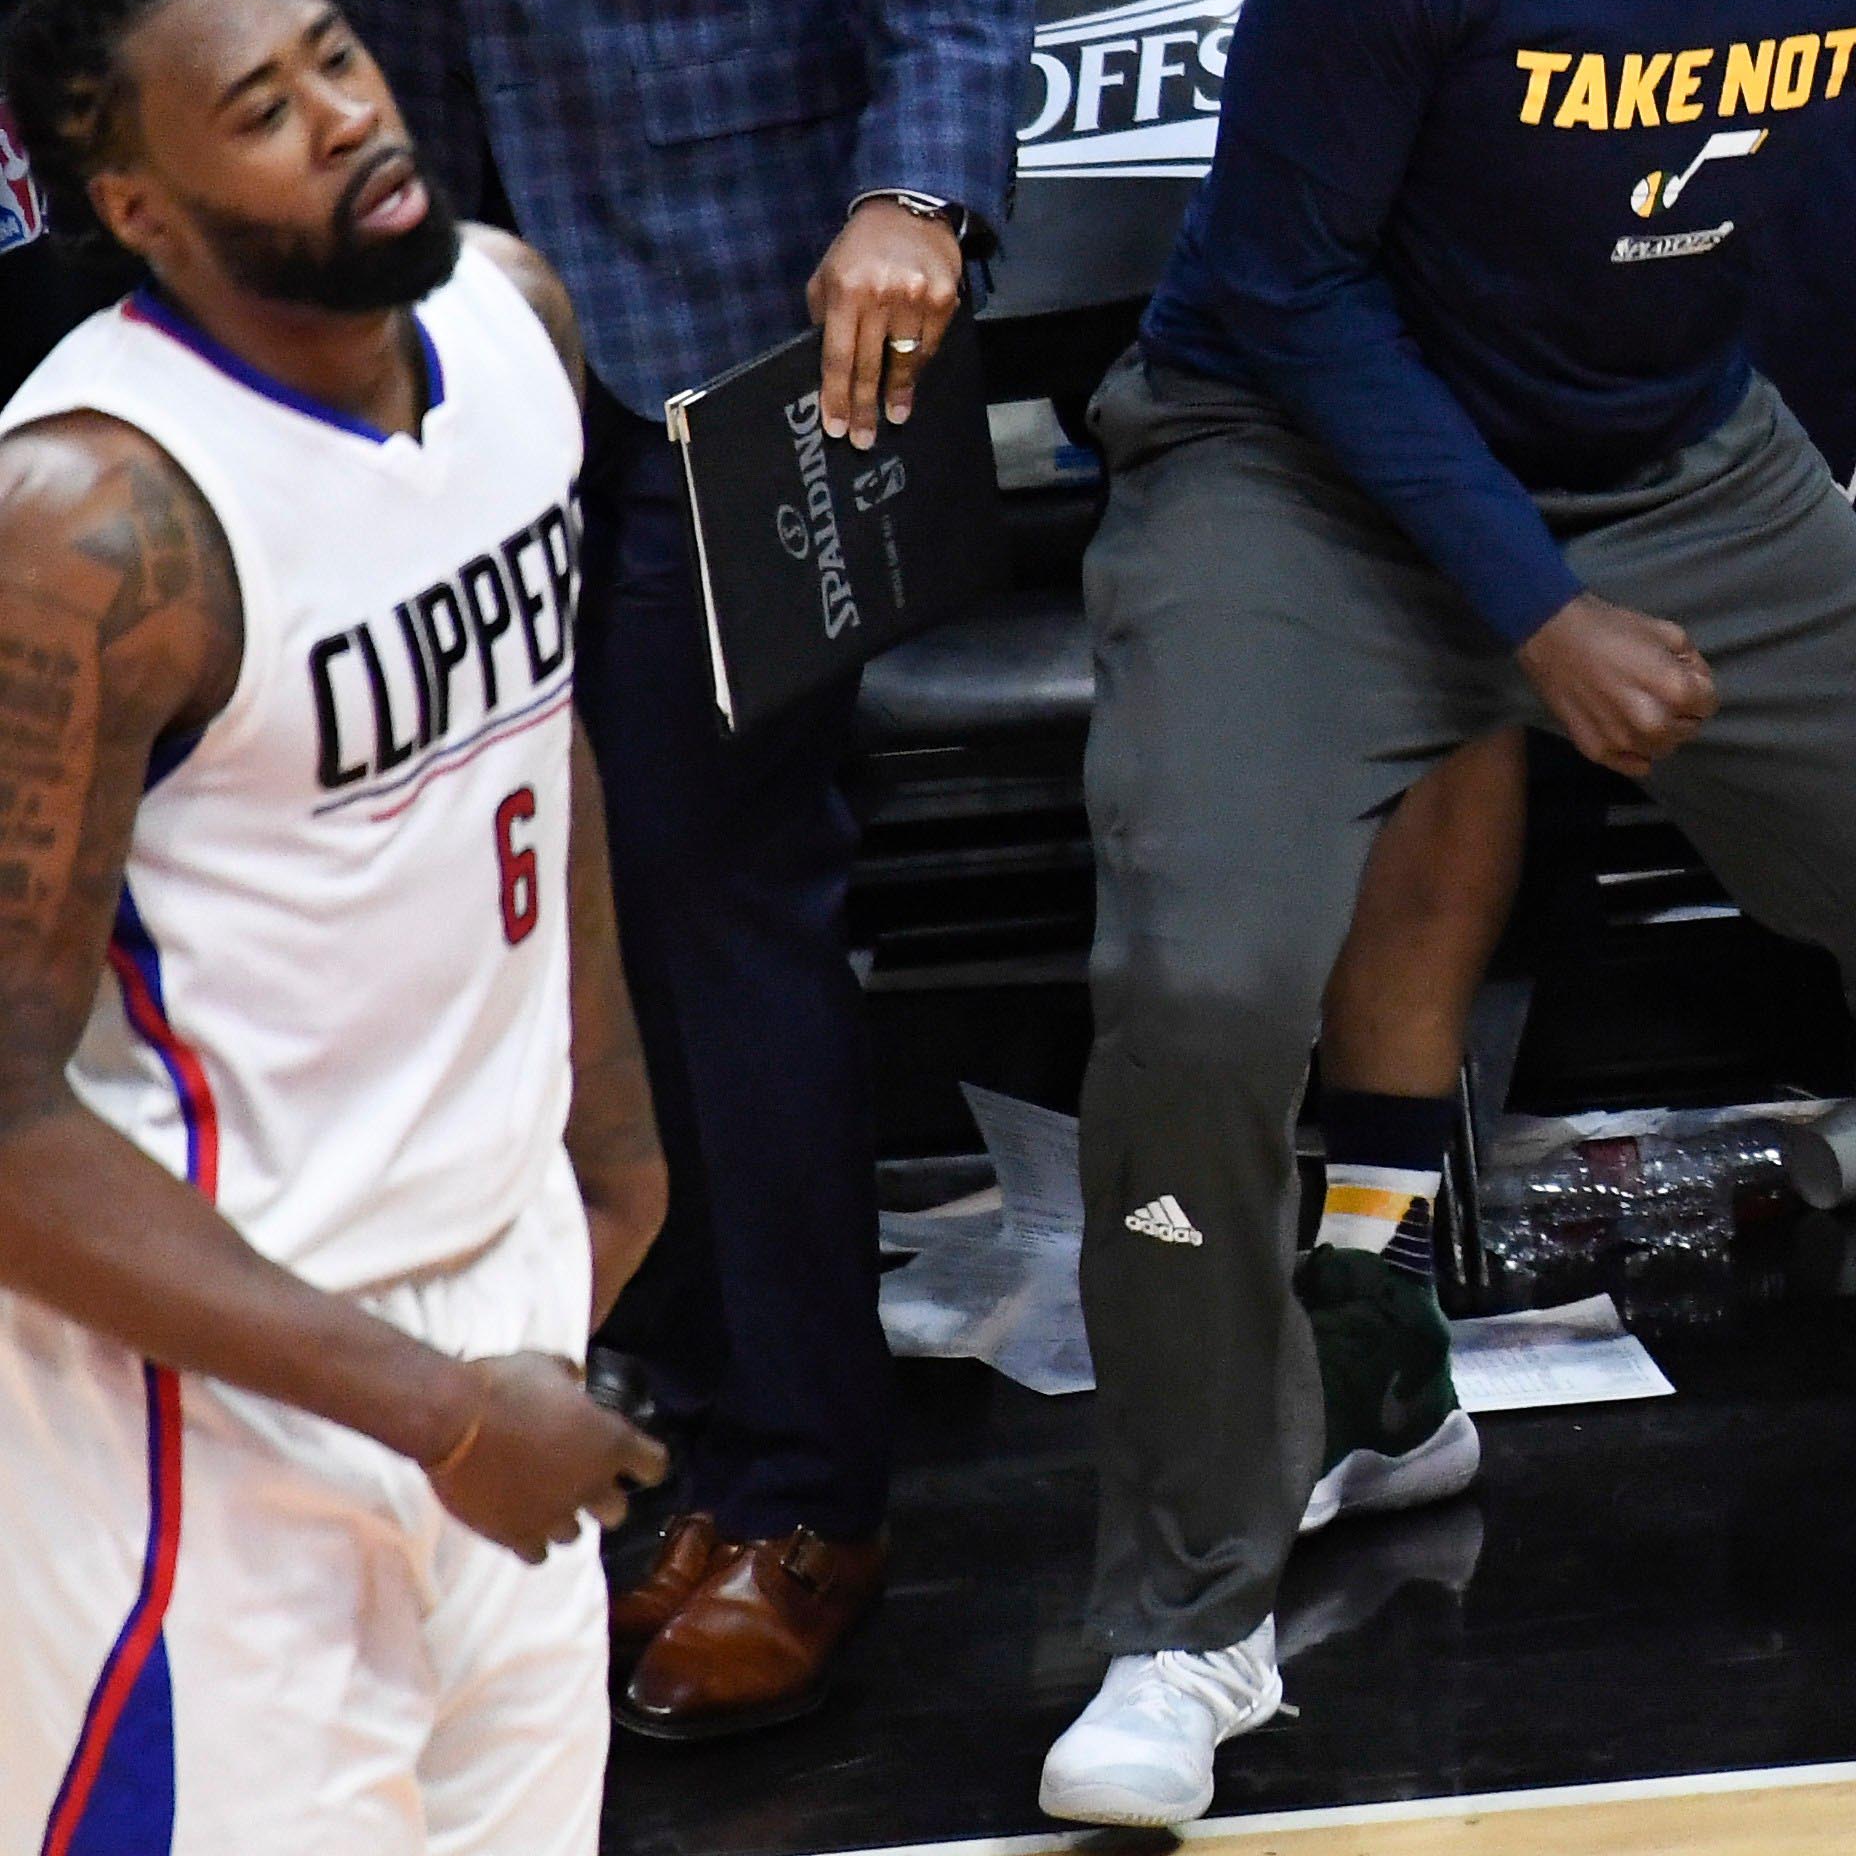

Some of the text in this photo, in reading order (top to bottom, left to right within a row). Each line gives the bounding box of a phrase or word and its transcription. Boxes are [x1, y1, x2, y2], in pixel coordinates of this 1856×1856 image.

[1516, 48, 1714, 130] TAKE
[783, 390, 861, 640] SPALDING
[308, 484, 582, 789] CLIPPER
[495, 785, 538, 947] 6
